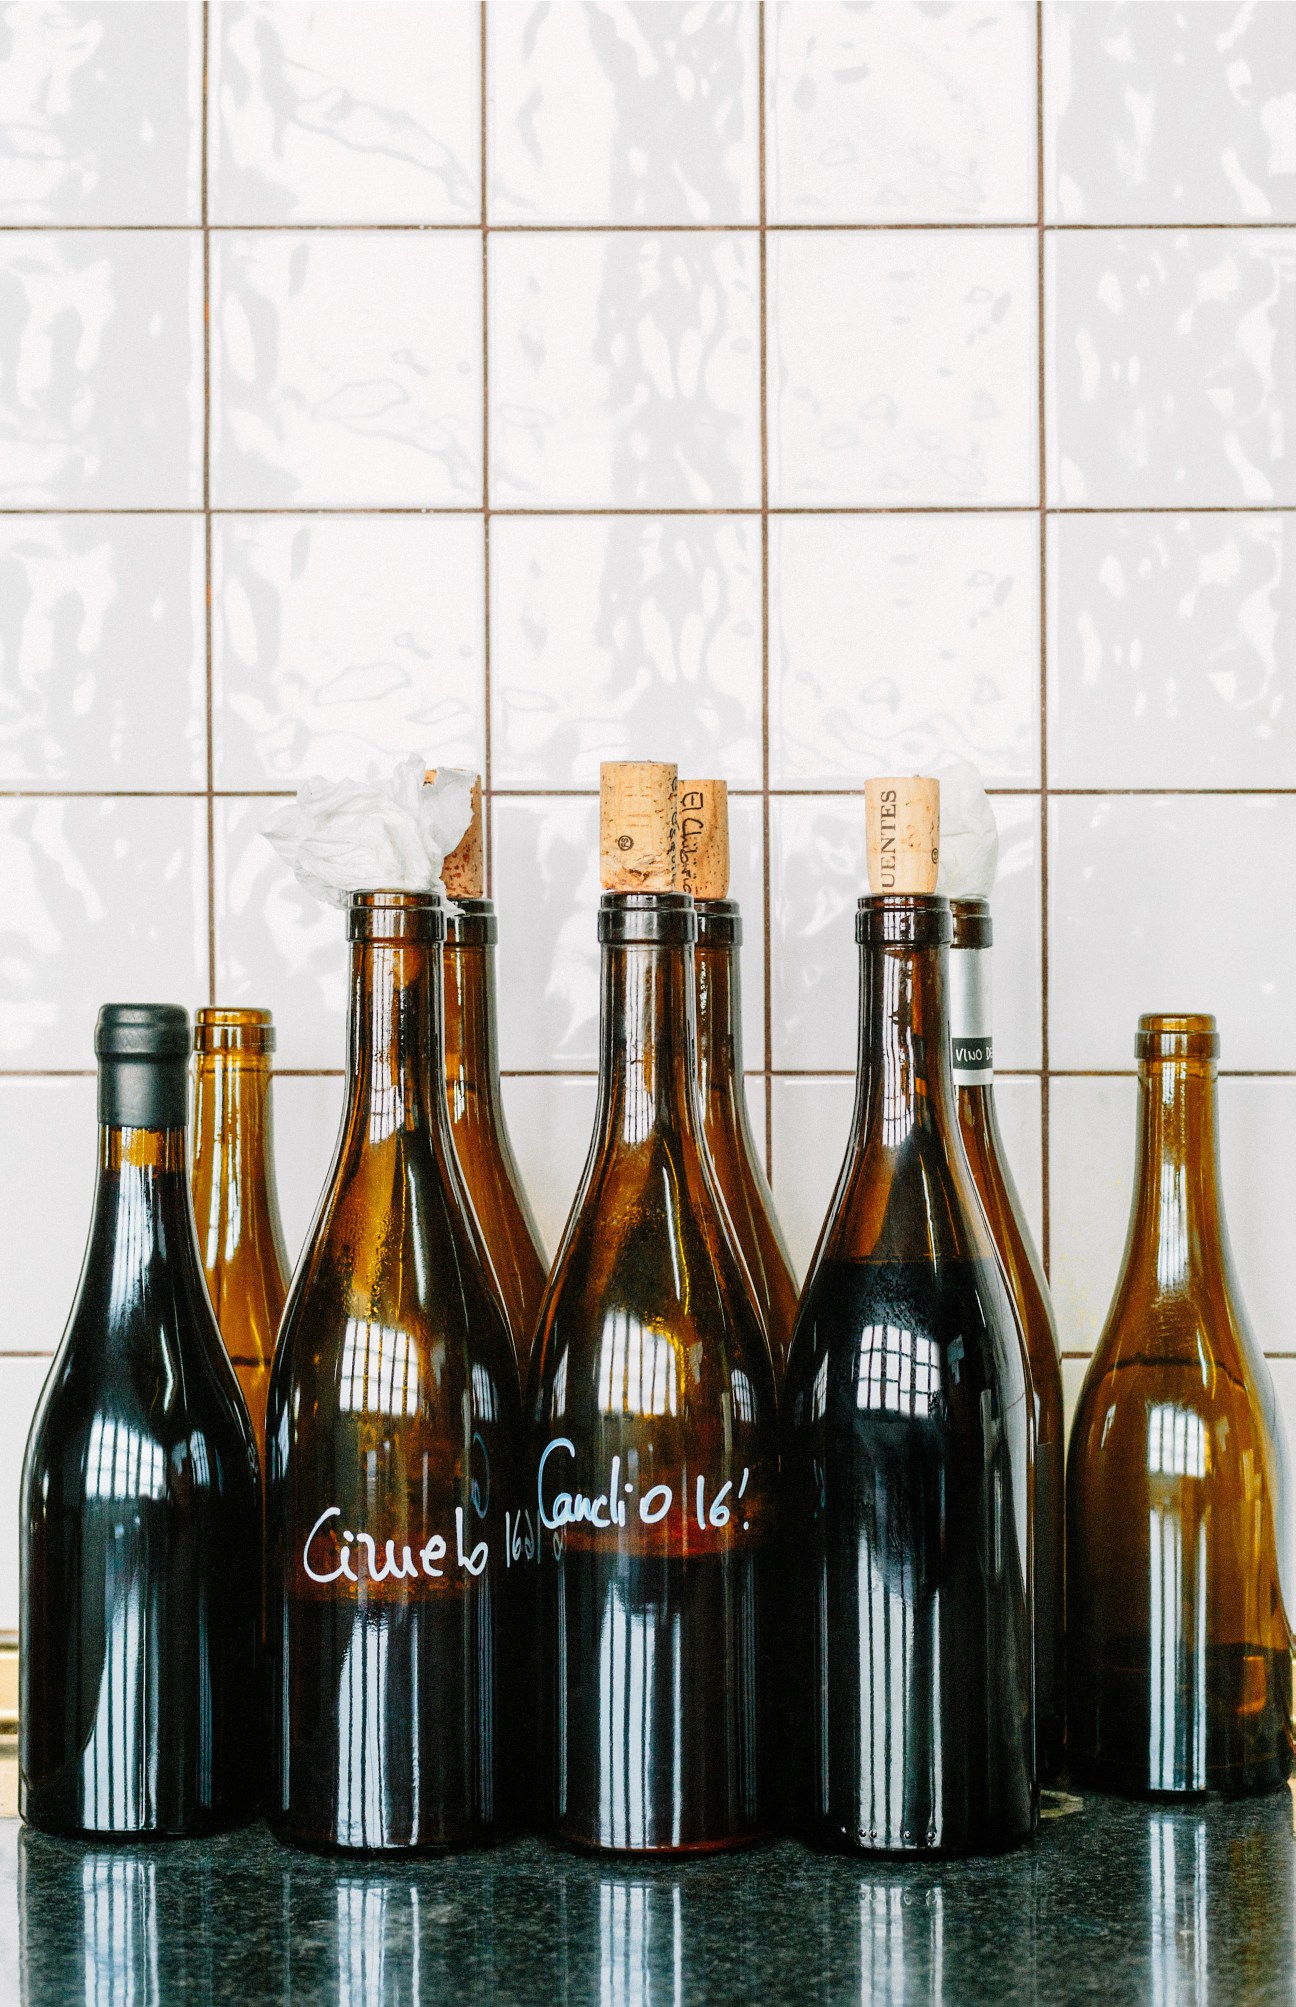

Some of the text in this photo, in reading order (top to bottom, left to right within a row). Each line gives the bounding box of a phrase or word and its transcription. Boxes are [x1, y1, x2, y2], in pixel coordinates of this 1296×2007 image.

[880, 789, 897, 894] UENTES
[955, 1047, 983, 1062] VINO
[696, 1467, 750, 1531] 16!
